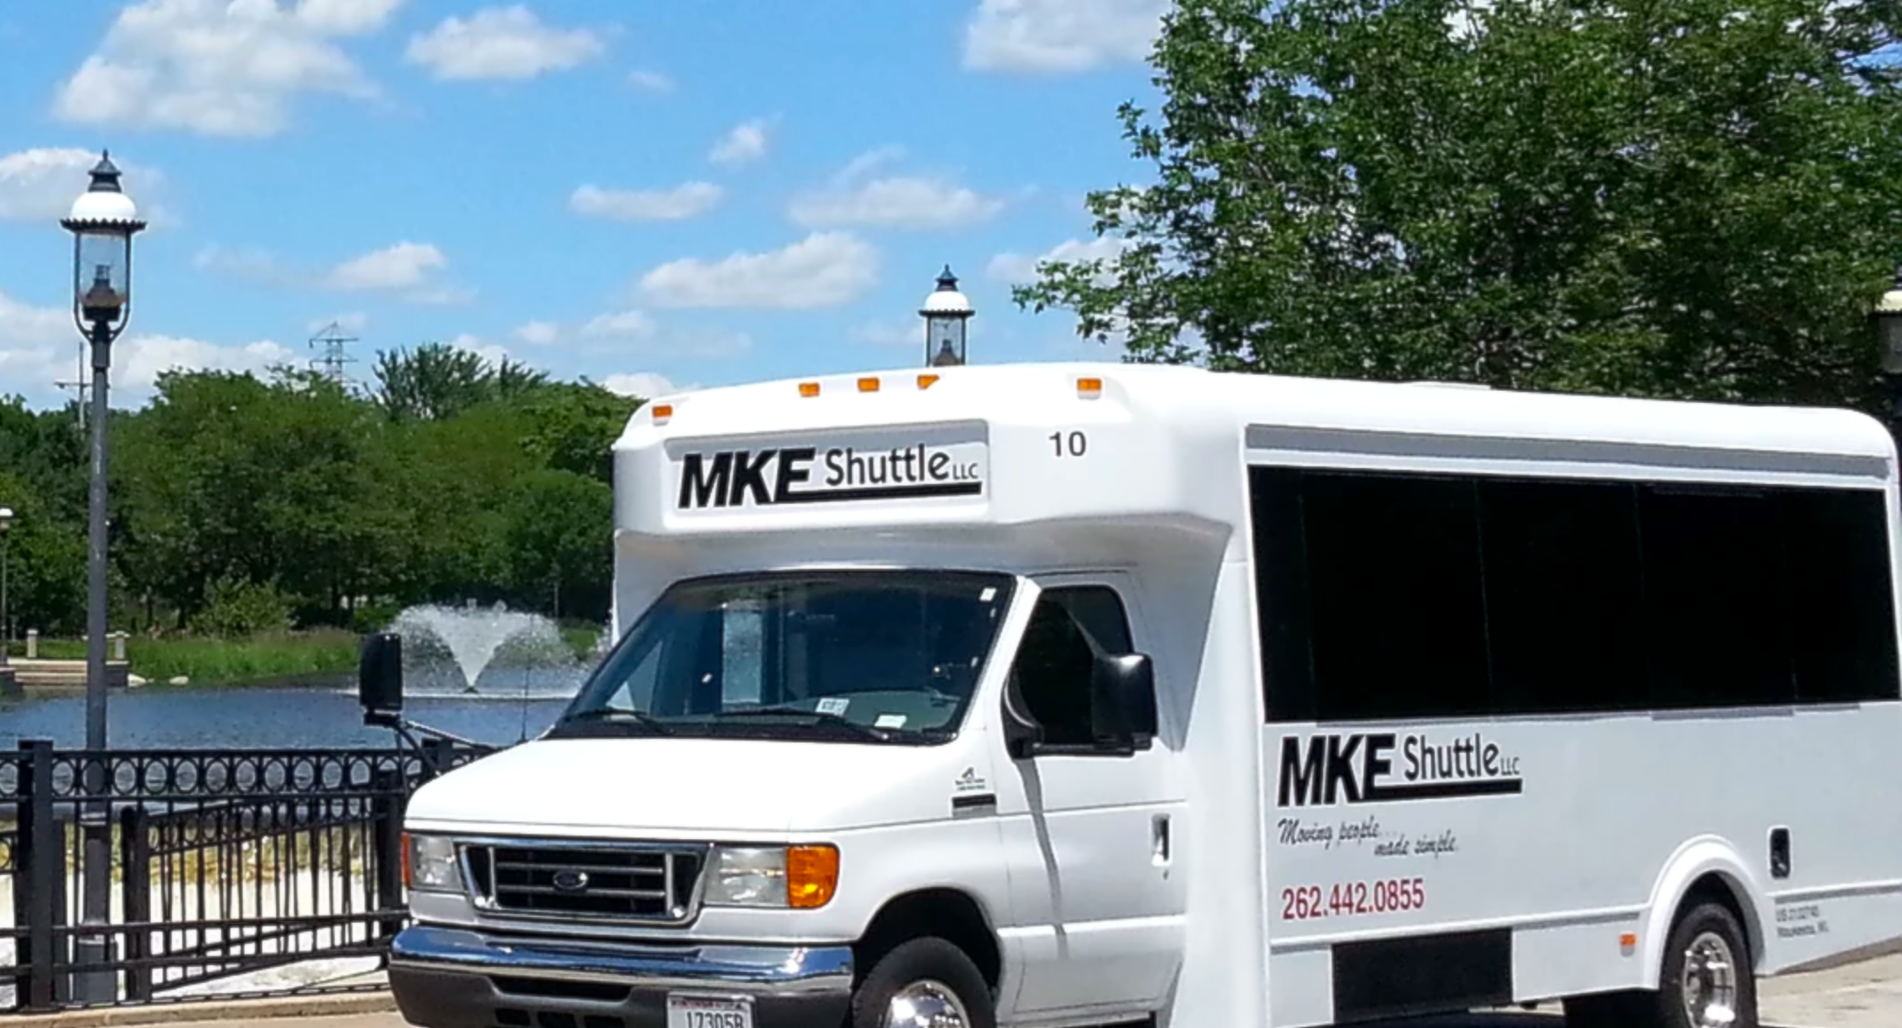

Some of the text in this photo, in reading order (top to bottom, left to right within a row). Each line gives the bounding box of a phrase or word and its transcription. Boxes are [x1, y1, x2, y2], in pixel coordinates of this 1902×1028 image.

[1049, 430, 1087, 458] 10
[678, 443, 979, 509] MKE Shuttle LLC
[1278, 732, 1520, 807] MKE Shuttle LLC
[1278, 818, 1333, 850] Moving
[1374, 834, 1409, 856] made
[1281, 878, 1425, 921] 262.442.0855
